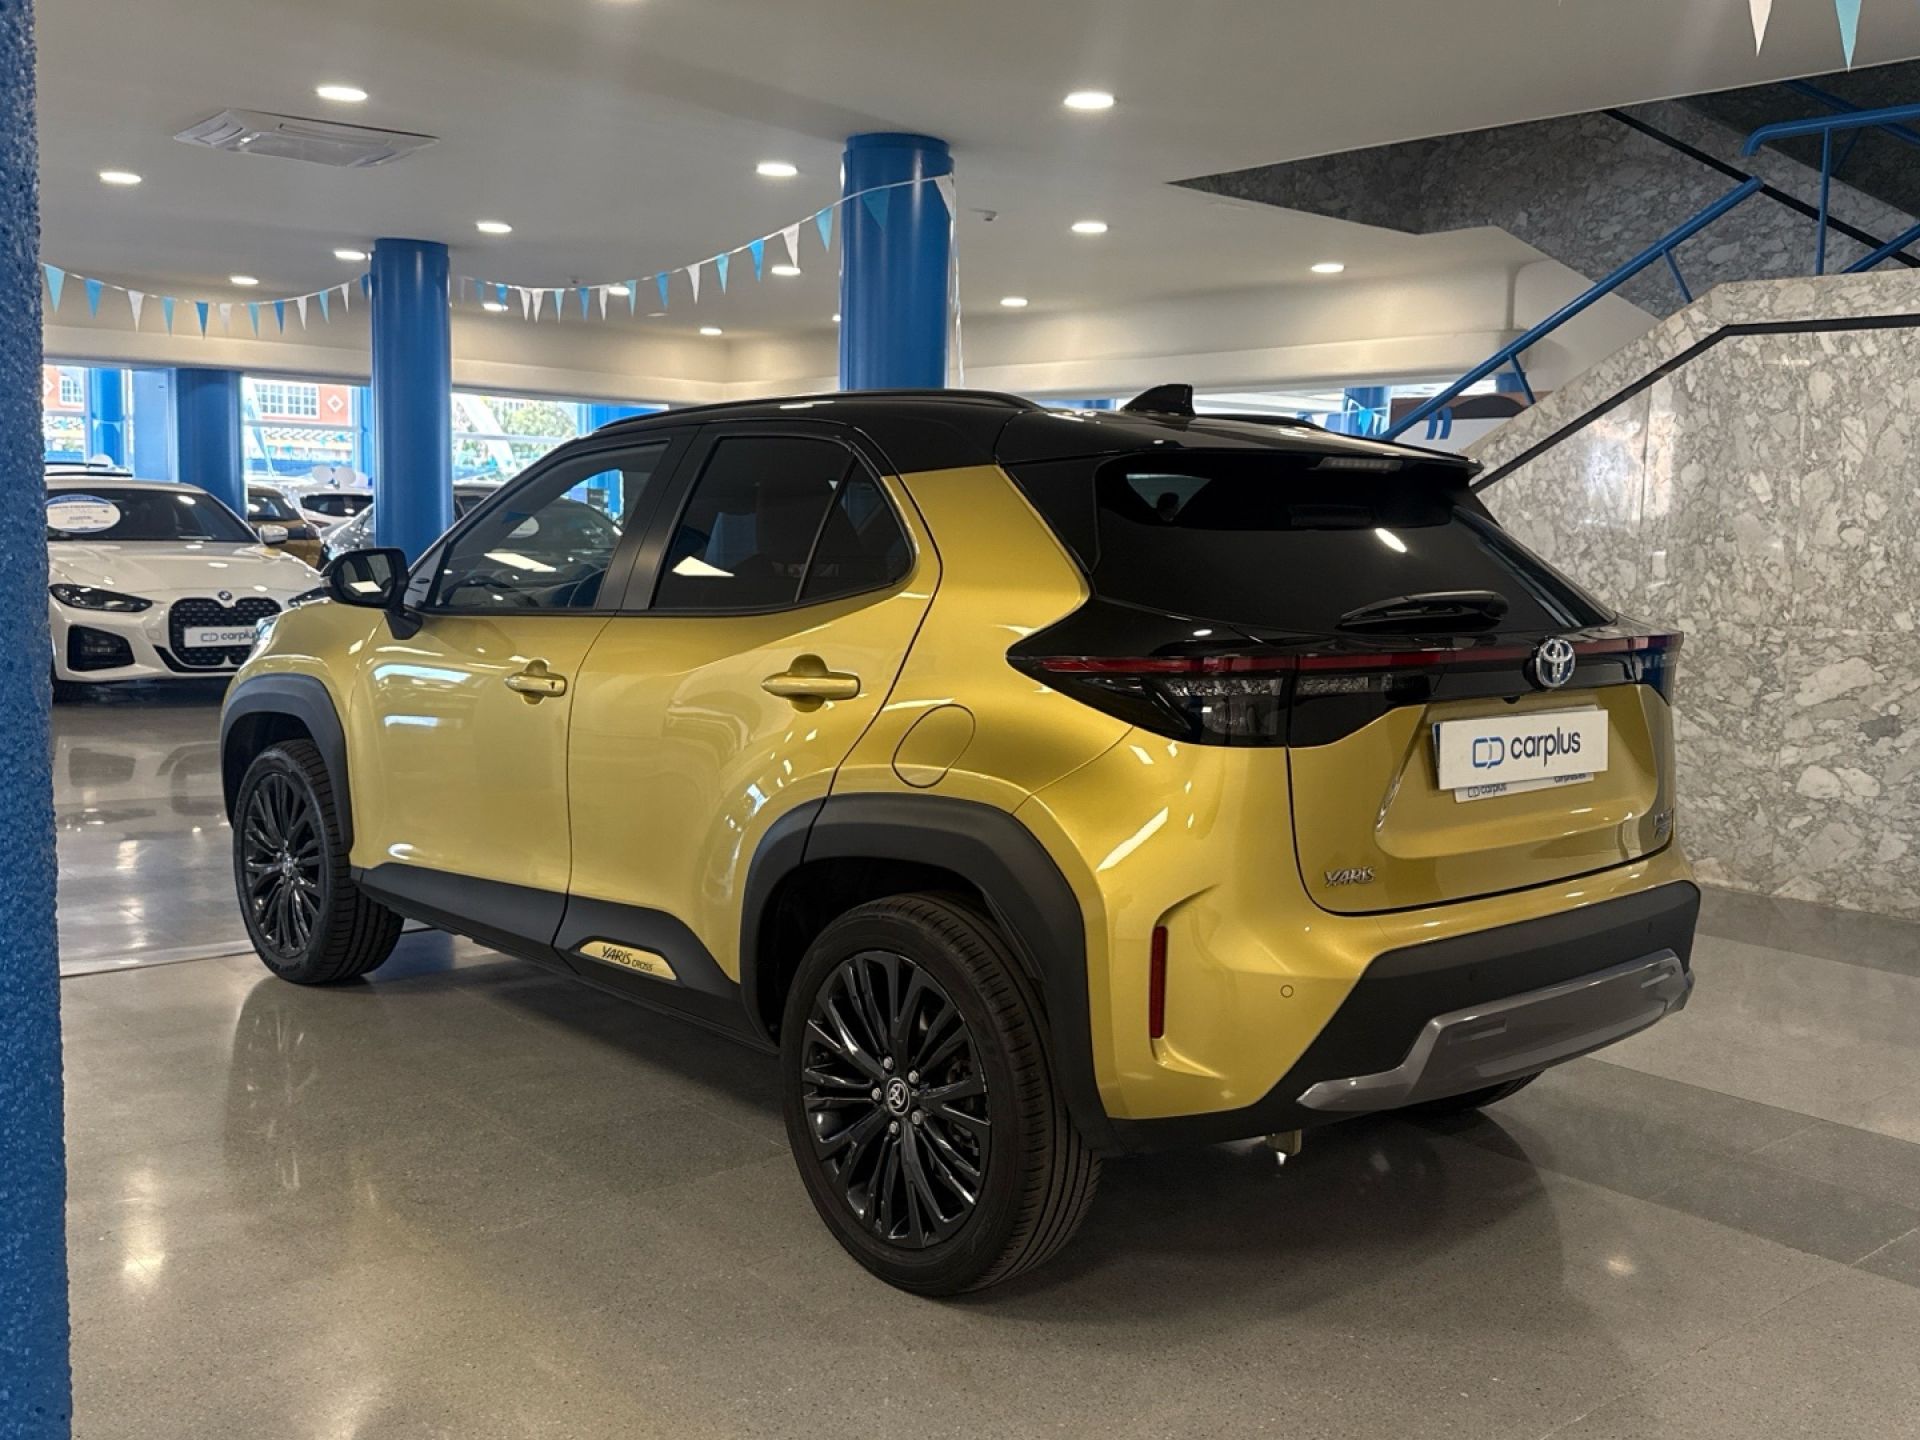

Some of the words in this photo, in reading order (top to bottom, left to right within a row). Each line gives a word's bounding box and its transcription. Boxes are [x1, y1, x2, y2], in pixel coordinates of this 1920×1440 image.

[220, 628, 257, 642] carplu
[1511, 726, 1581, 767] carplus
[1324, 866, 1376, 888] YARIS
[602, 945, 632, 965] YARIS
[631, 959, 654, 972] CROSS
